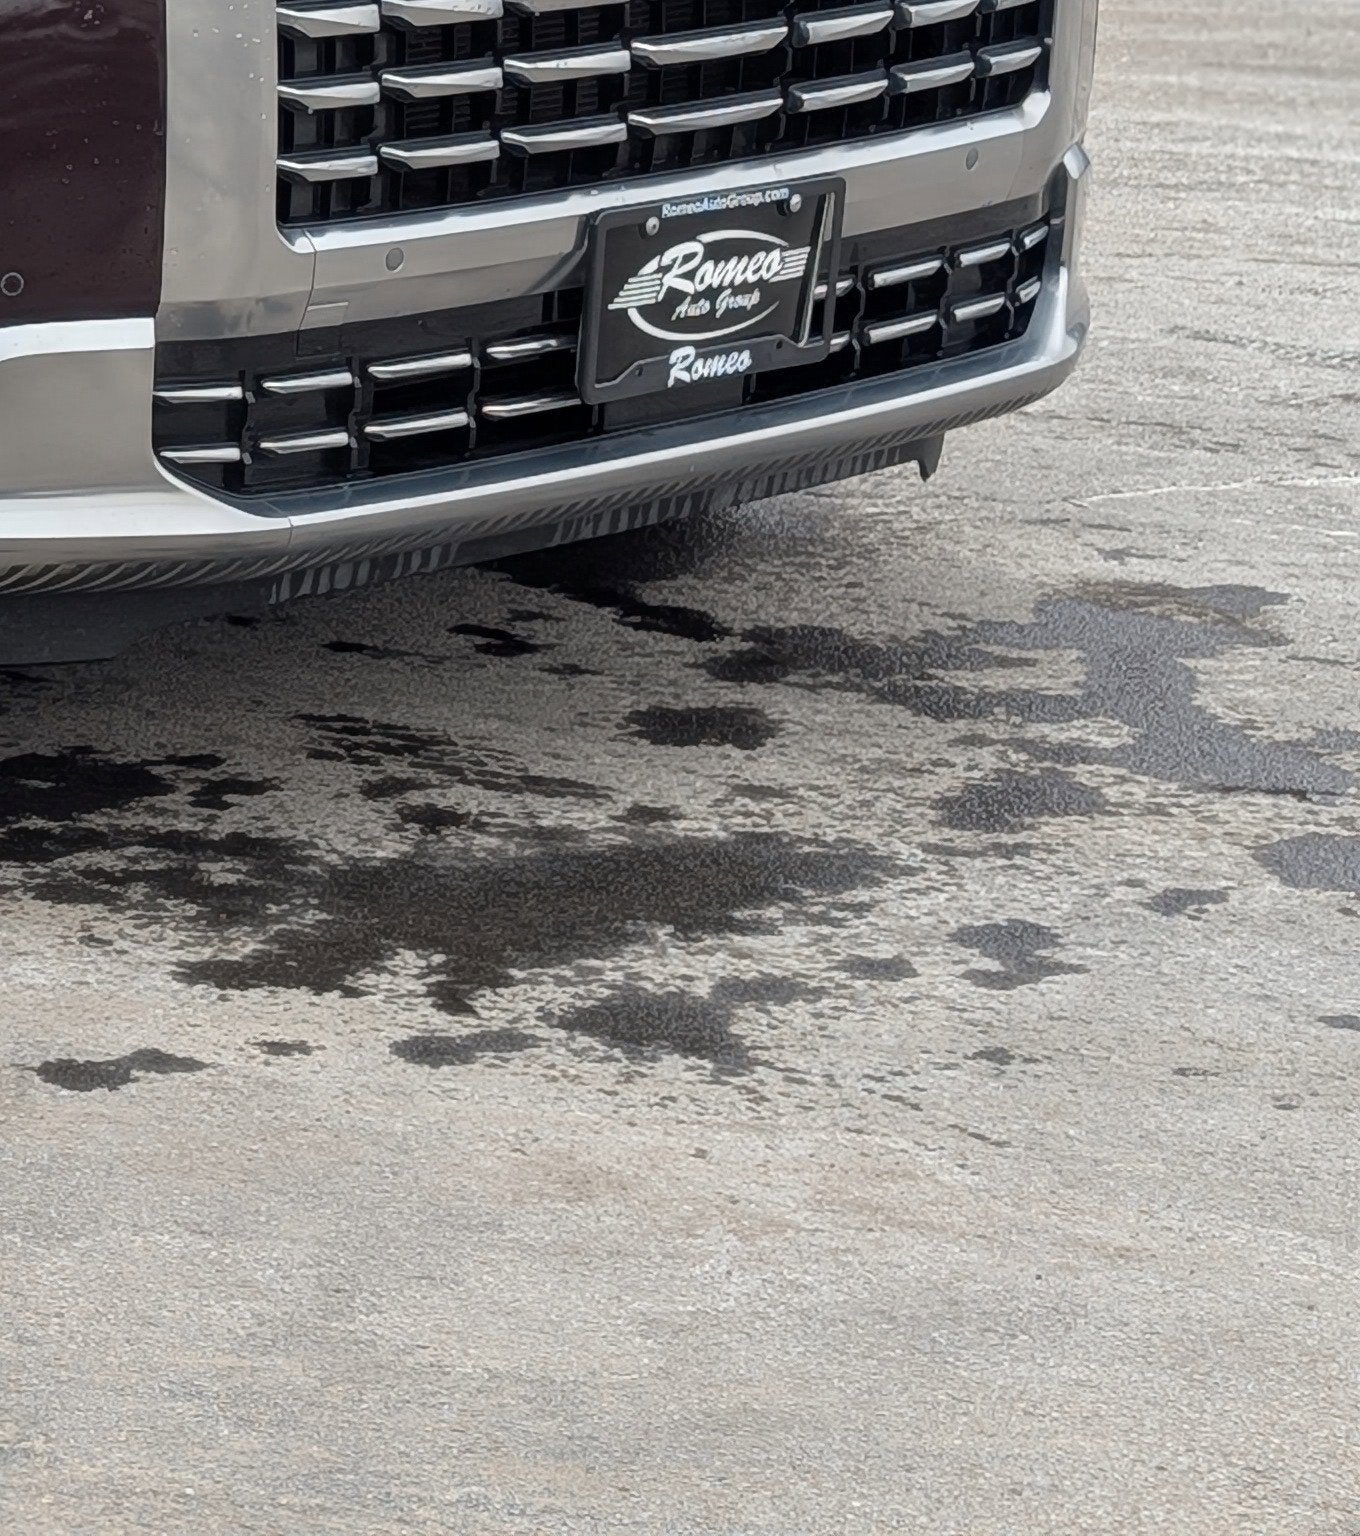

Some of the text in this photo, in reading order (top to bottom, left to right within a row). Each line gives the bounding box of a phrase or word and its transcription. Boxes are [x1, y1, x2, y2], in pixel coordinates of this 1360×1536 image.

[661, 188, 790, 219] RomeoAutoGroup.com
[657, 240, 783, 302] Romeo
[671, 287, 761, 322] Auto Group
[667, 345, 753, 388] Romeo
